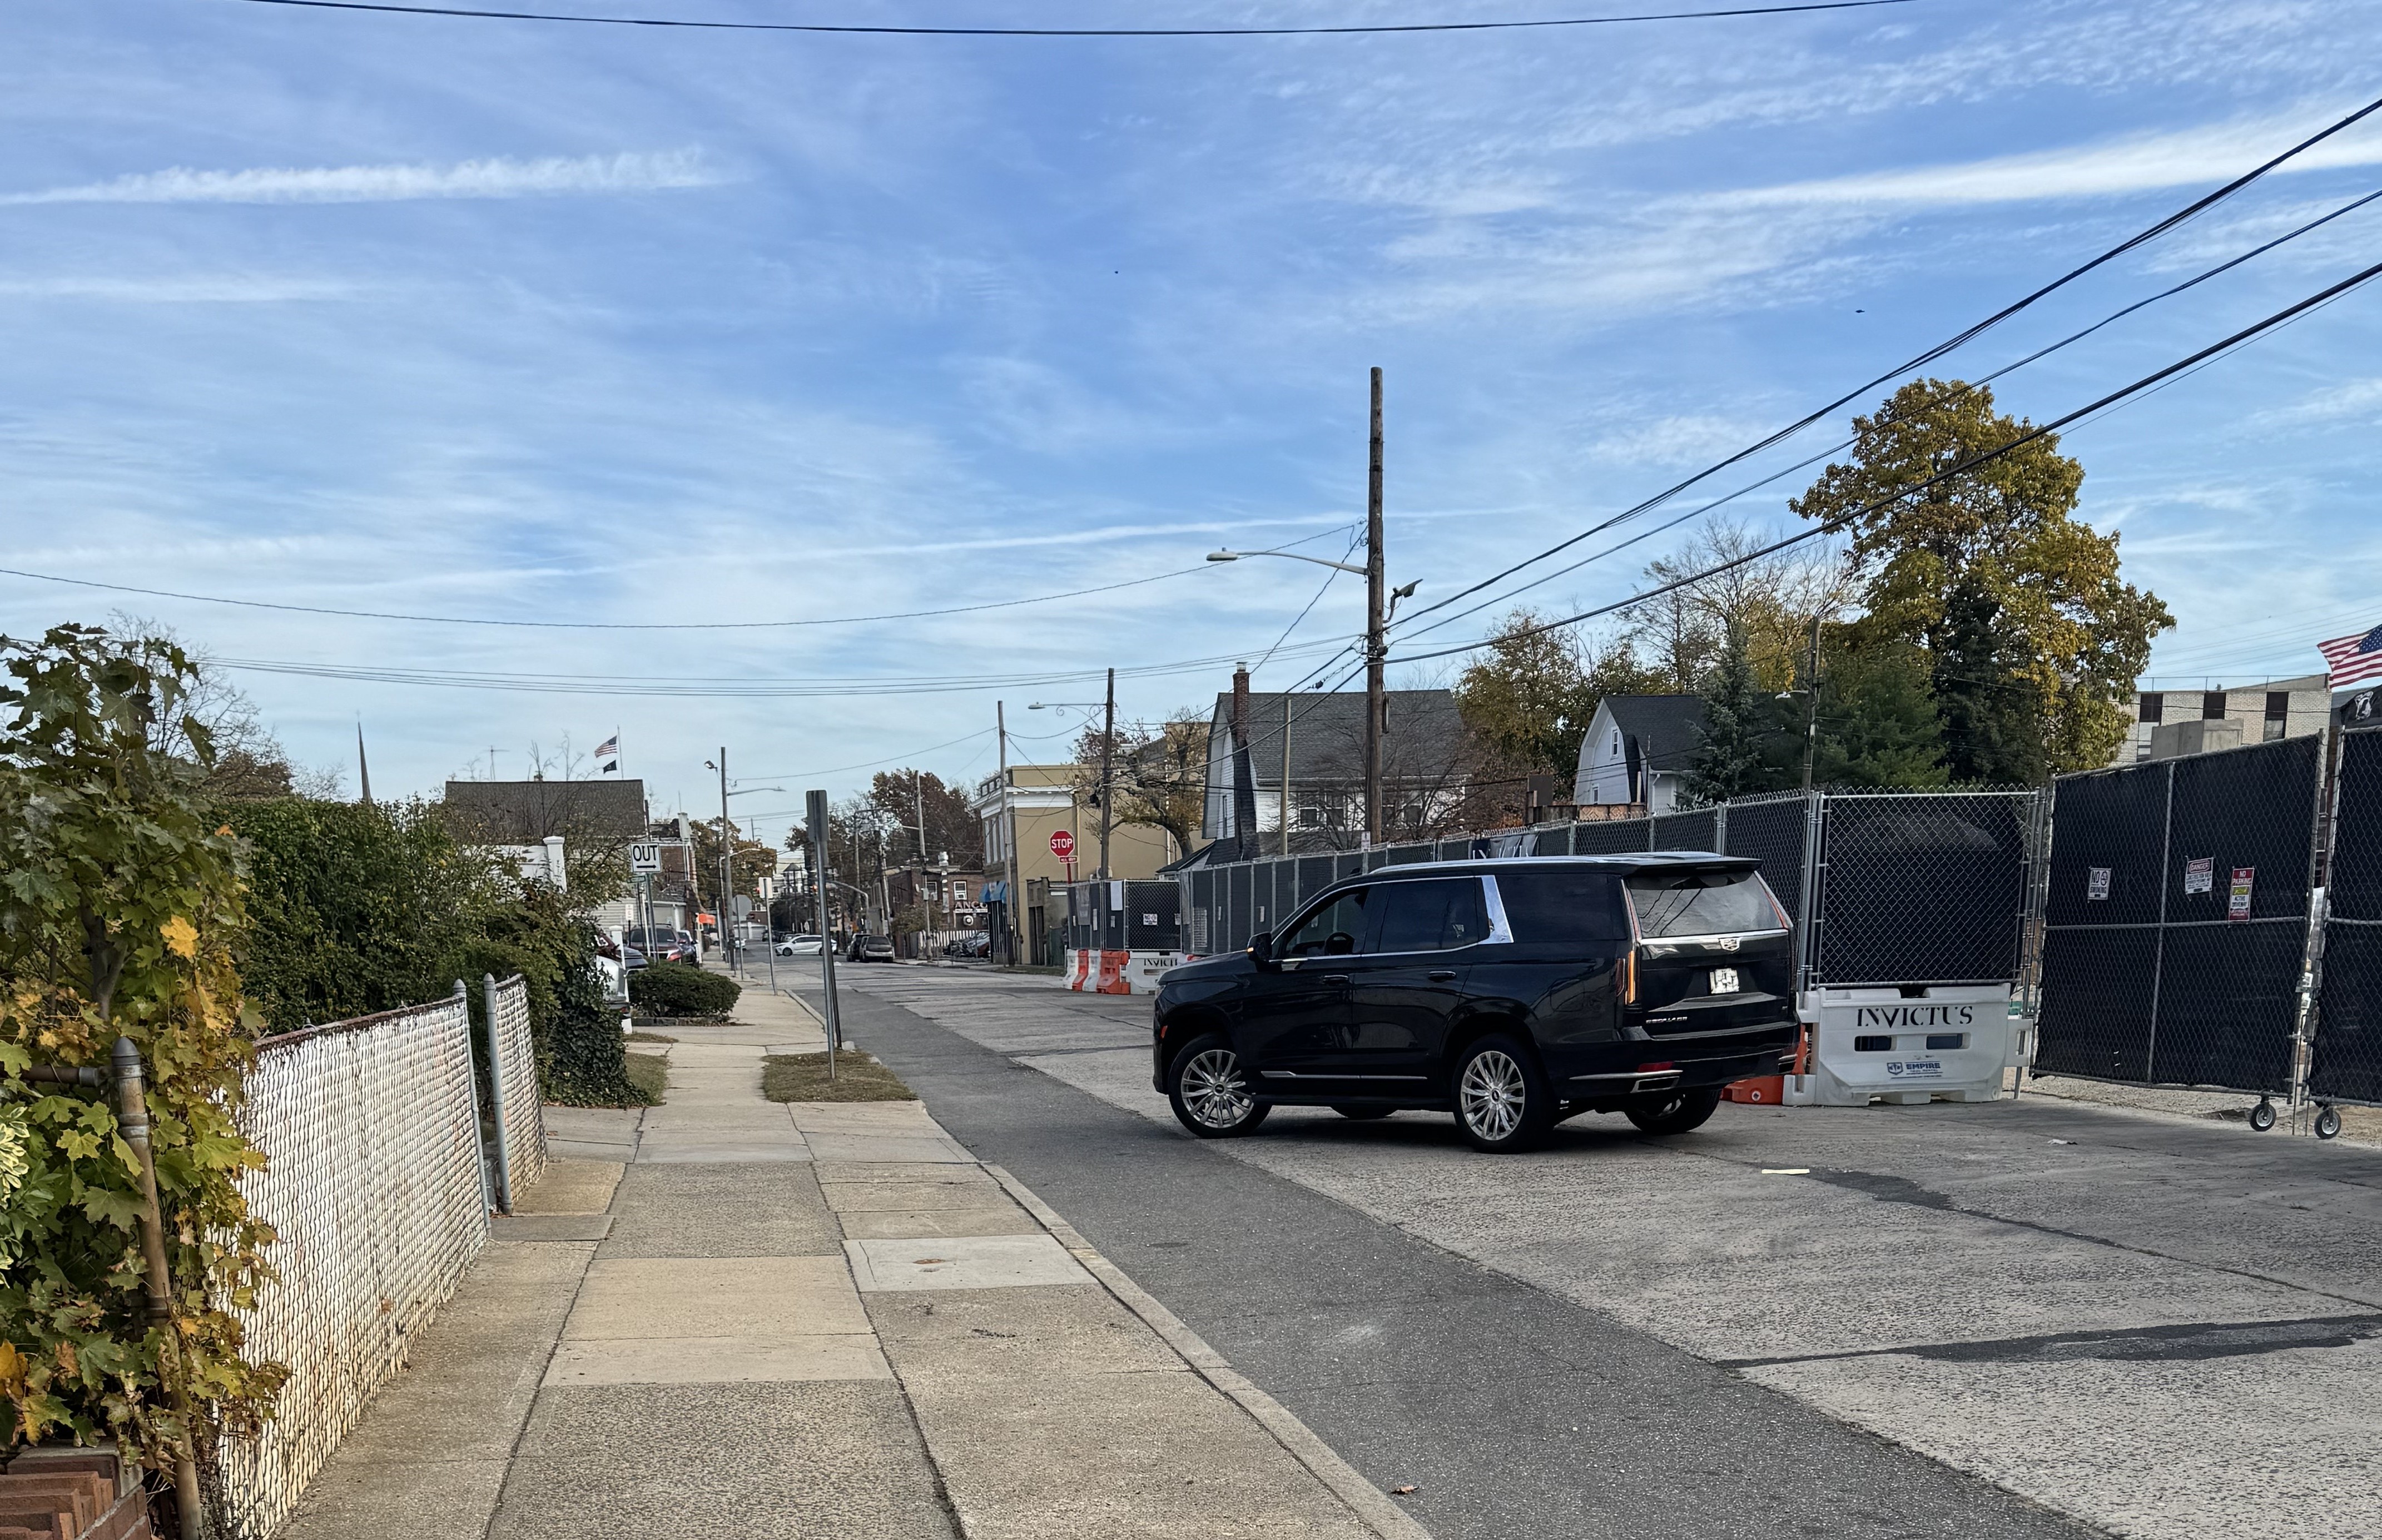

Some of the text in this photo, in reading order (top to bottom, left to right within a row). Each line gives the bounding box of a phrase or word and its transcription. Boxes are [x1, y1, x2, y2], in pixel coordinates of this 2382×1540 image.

[1051, 838, 1073, 848] STOP
[633, 845, 657, 861] OUT
[2091, 871, 2100, 883] NO
[1857, 1006, 1973, 1028] INVICTUS
